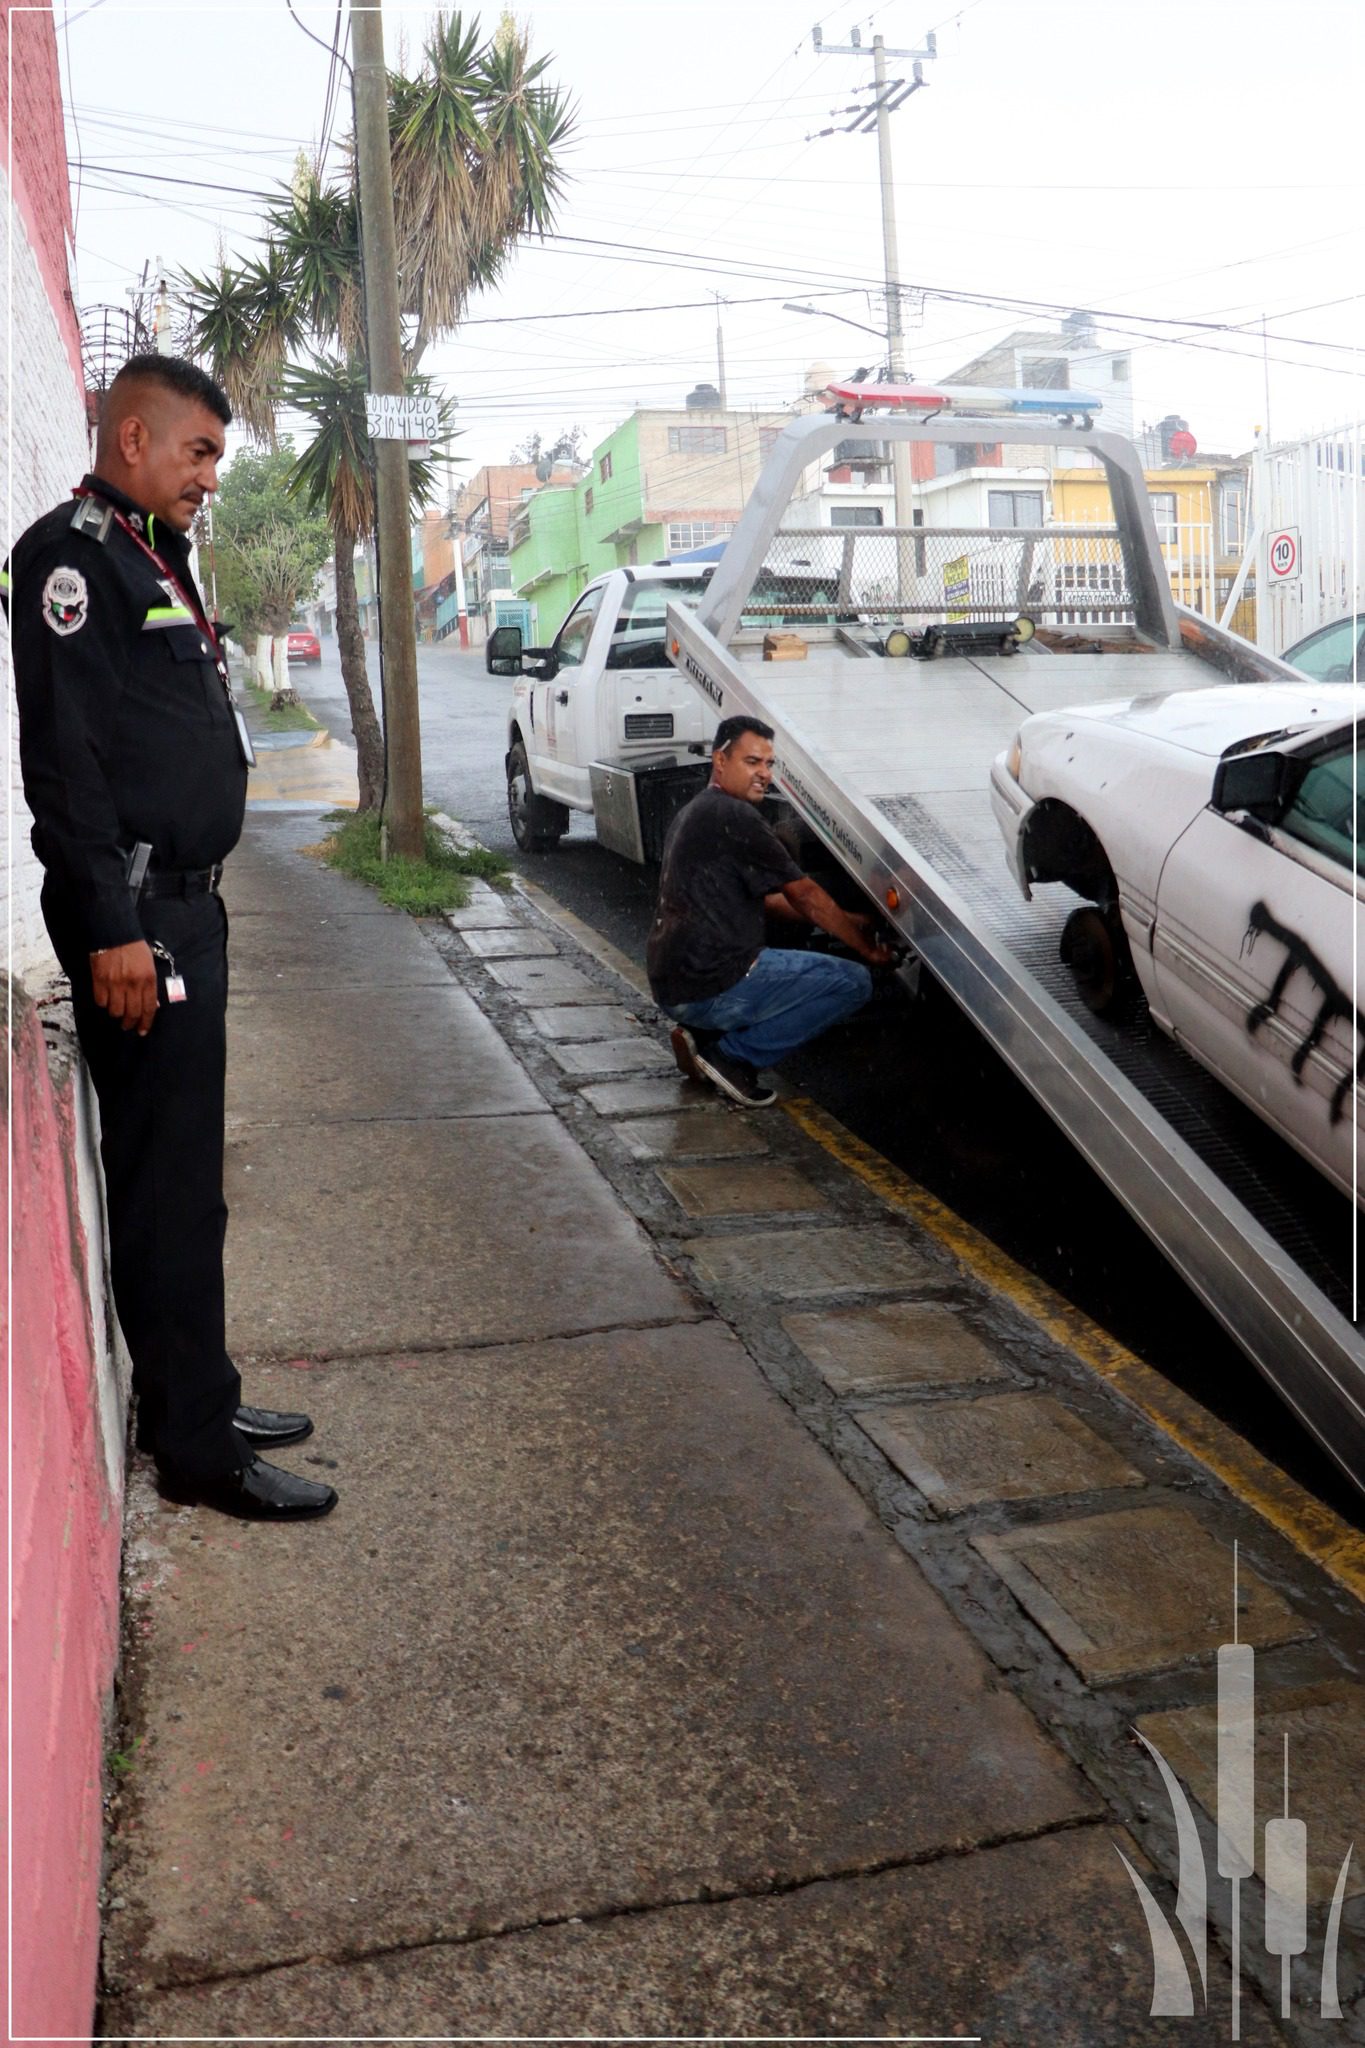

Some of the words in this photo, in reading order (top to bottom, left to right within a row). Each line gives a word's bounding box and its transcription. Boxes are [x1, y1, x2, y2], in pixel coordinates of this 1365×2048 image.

[395, 396, 432, 414] VIDEO
[1276, 543, 1289, 561] 10
[782, 761, 831, 827] Transformando
[832, 820, 862, 865] Tultitlán
